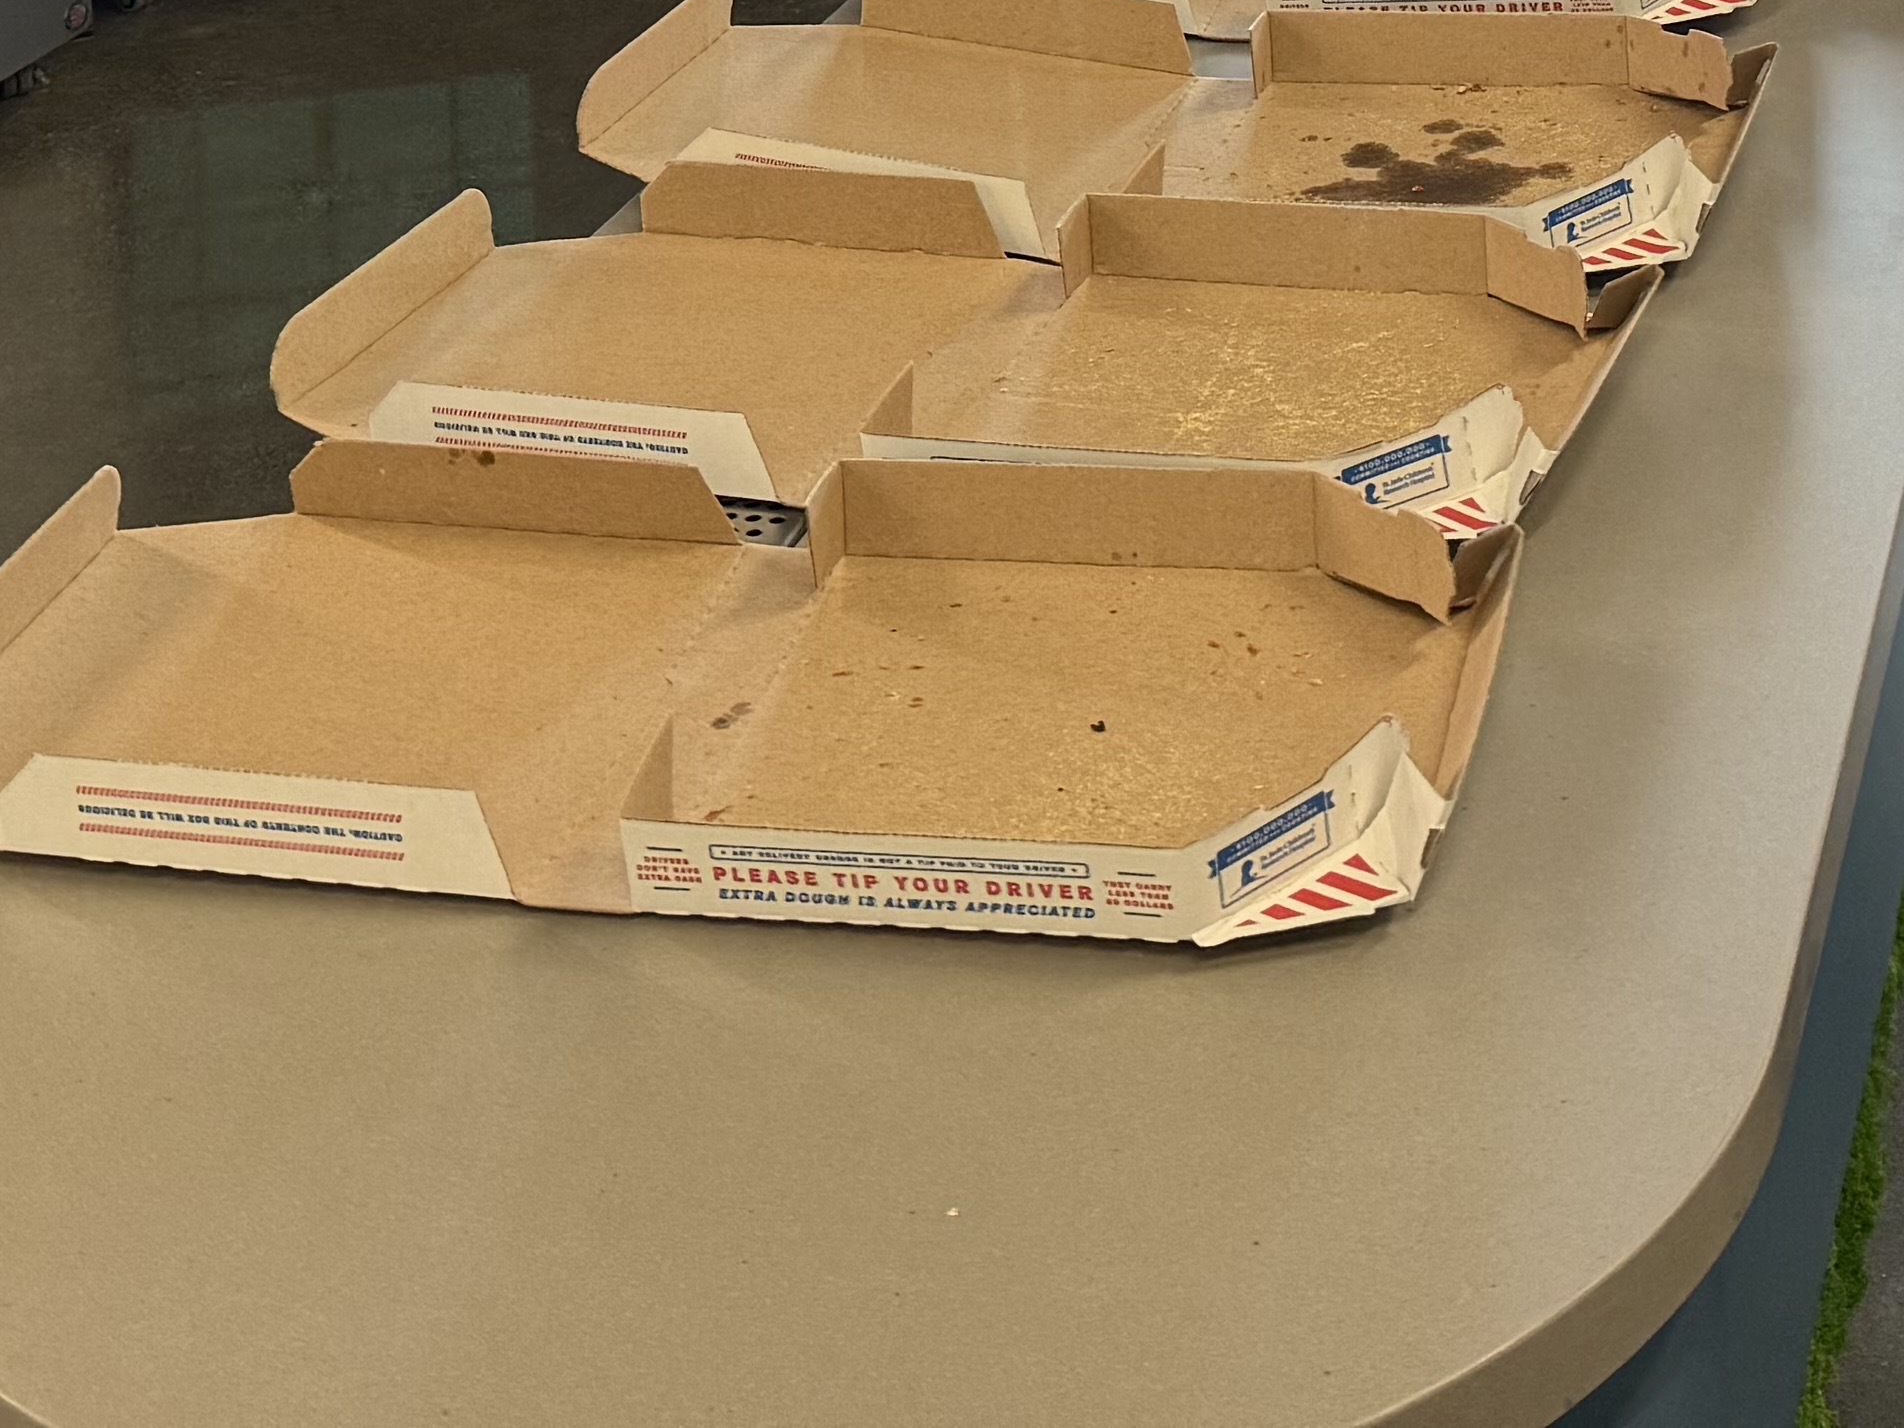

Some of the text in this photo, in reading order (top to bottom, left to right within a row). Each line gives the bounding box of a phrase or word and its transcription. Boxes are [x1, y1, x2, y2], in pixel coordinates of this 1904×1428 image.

[1496, 1, 1564, 13] DRIVER
[77, 804, 136, 818] DELICIOUS
[139, 810, 154, 820] BE
[157, 812, 185, 823] WILL
[187, 814, 211, 825] BOX
[213, 816, 241, 828] THIS
[242, 819, 258, 829] OF
[260, 820, 320, 835] CONTENTS
[323, 826, 346, 838] THE
[712, 866, 1094, 901] PLEASE TIP YOUR DRIVER
[719, 888, 1096, 919] EXTRA DOUGH IS ALWAYS APPRECIATED
